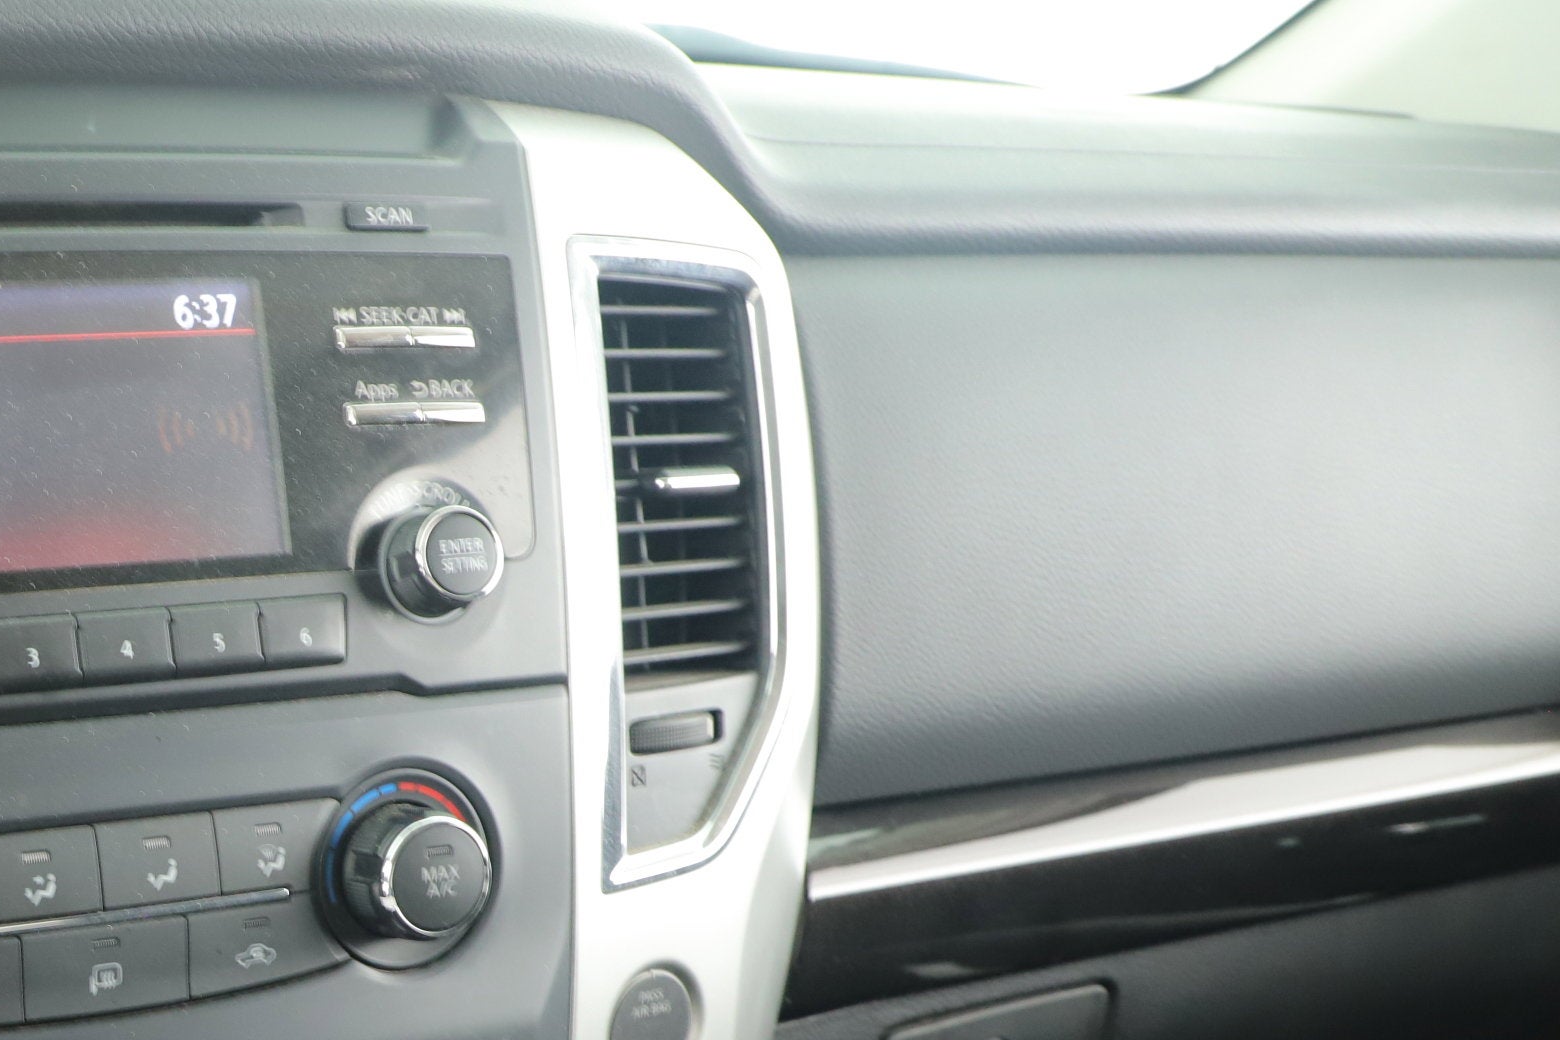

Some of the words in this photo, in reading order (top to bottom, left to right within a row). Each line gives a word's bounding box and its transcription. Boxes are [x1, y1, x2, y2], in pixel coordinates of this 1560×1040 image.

[365, 206, 414, 225] SCAN
[173, 293, 238, 330] 6:37
[355, 380, 399, 402] Apps
[428, 379, 475, 398] BACK
[438, 537, 484, 554] ENTER
[213, 632, 226, 653] 5
[299, 627, 312, 647] 6
[25, 647, 40, 668] 3
[120, 639, 134, 659] 4
[421, 864, 460, 883] MAX
[426, 880, 458, 898] A/C
